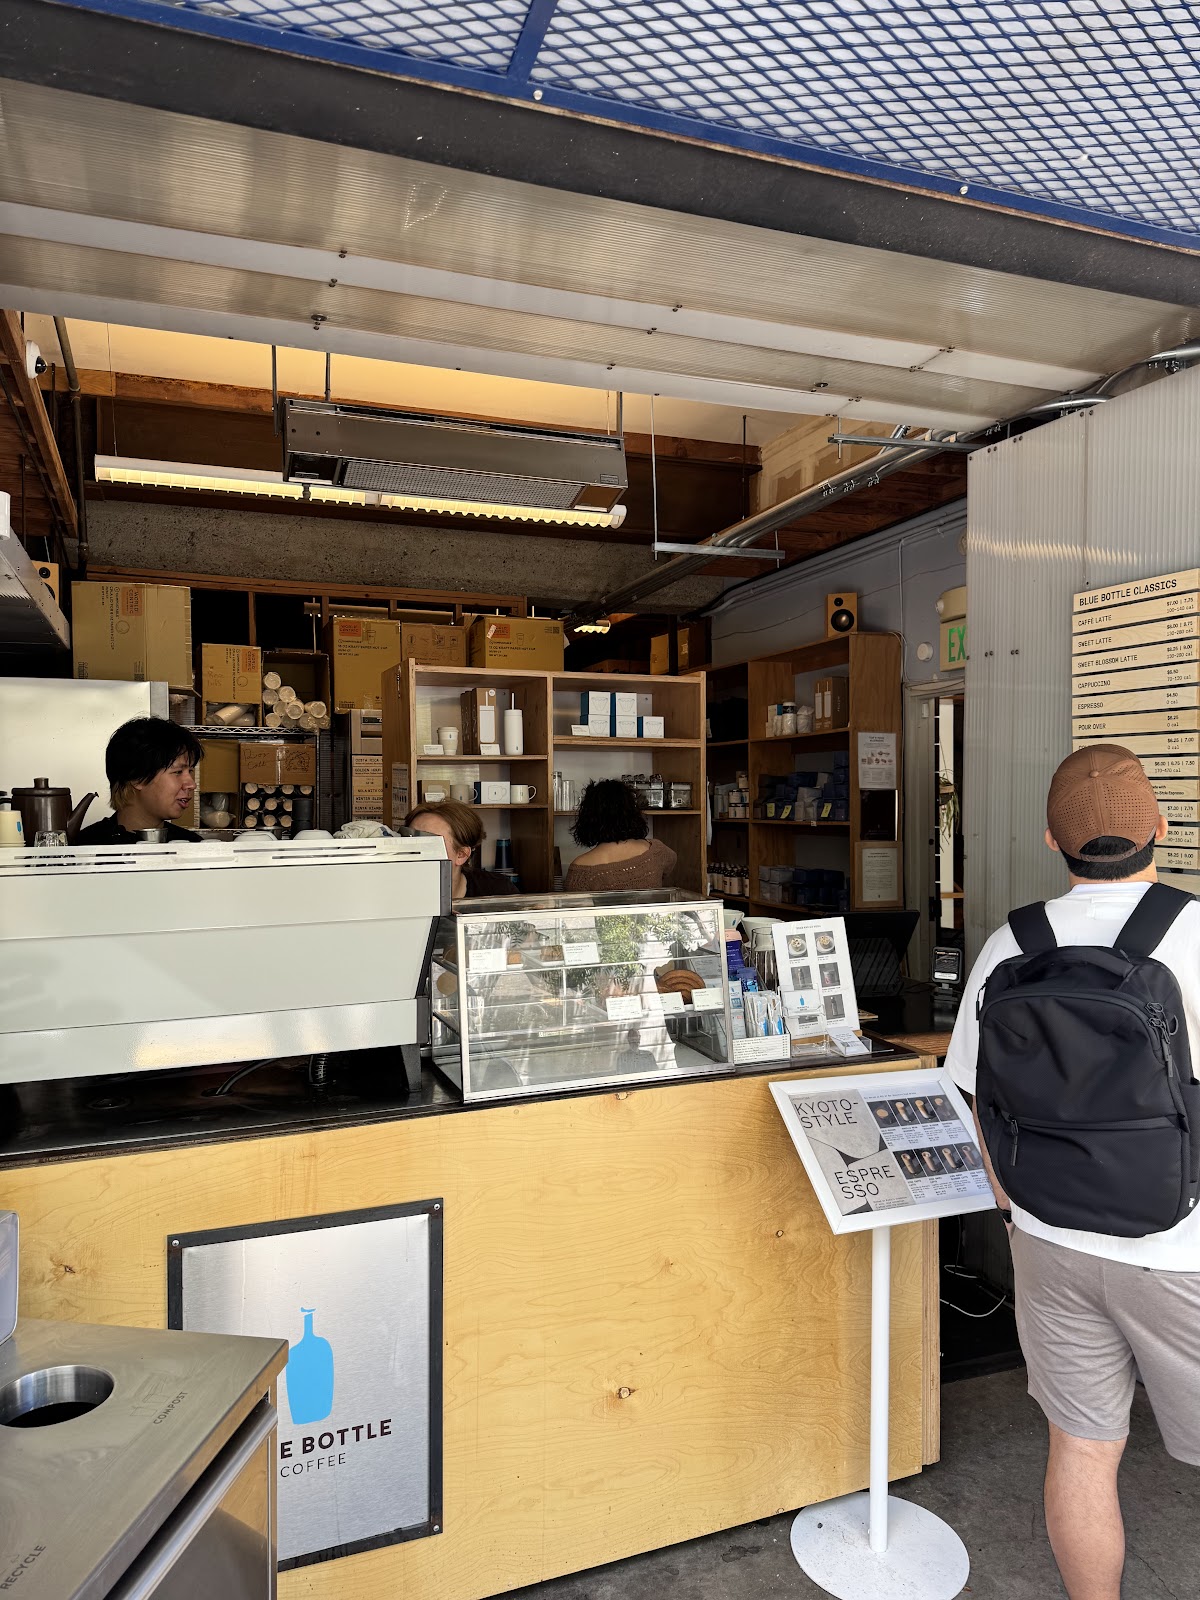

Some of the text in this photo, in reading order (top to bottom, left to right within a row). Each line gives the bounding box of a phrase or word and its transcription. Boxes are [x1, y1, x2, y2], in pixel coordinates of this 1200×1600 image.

[1079, 579, 1177, 607] BLUE BOTTLE CLASSICS
[1095, 614, 1112, 624] LATTE
[948, 624, 966, 662] EX
[1078, 637, 1112, 648] SWEET LATTE
[1078, 654, 1138, 669] SWEET BLOSSOM LATTE
[1078, 680, 1111, 689] CAPPUCCINO
[794, 1098, 859, 1115] KYOTO-
[800, 1112, 858, 1129] STYLE
[834, 1165, 895, 1185] ESPRE
[841, 1182, 880, 1199] SSO
[153, 1390, 188, 1425] COMPOST
[302, 1418, 392, 1454] BOTTLE
[280, 1452, 346, 1478] COFFEE
[0, 1544, 46, 1590] RECYCLE
